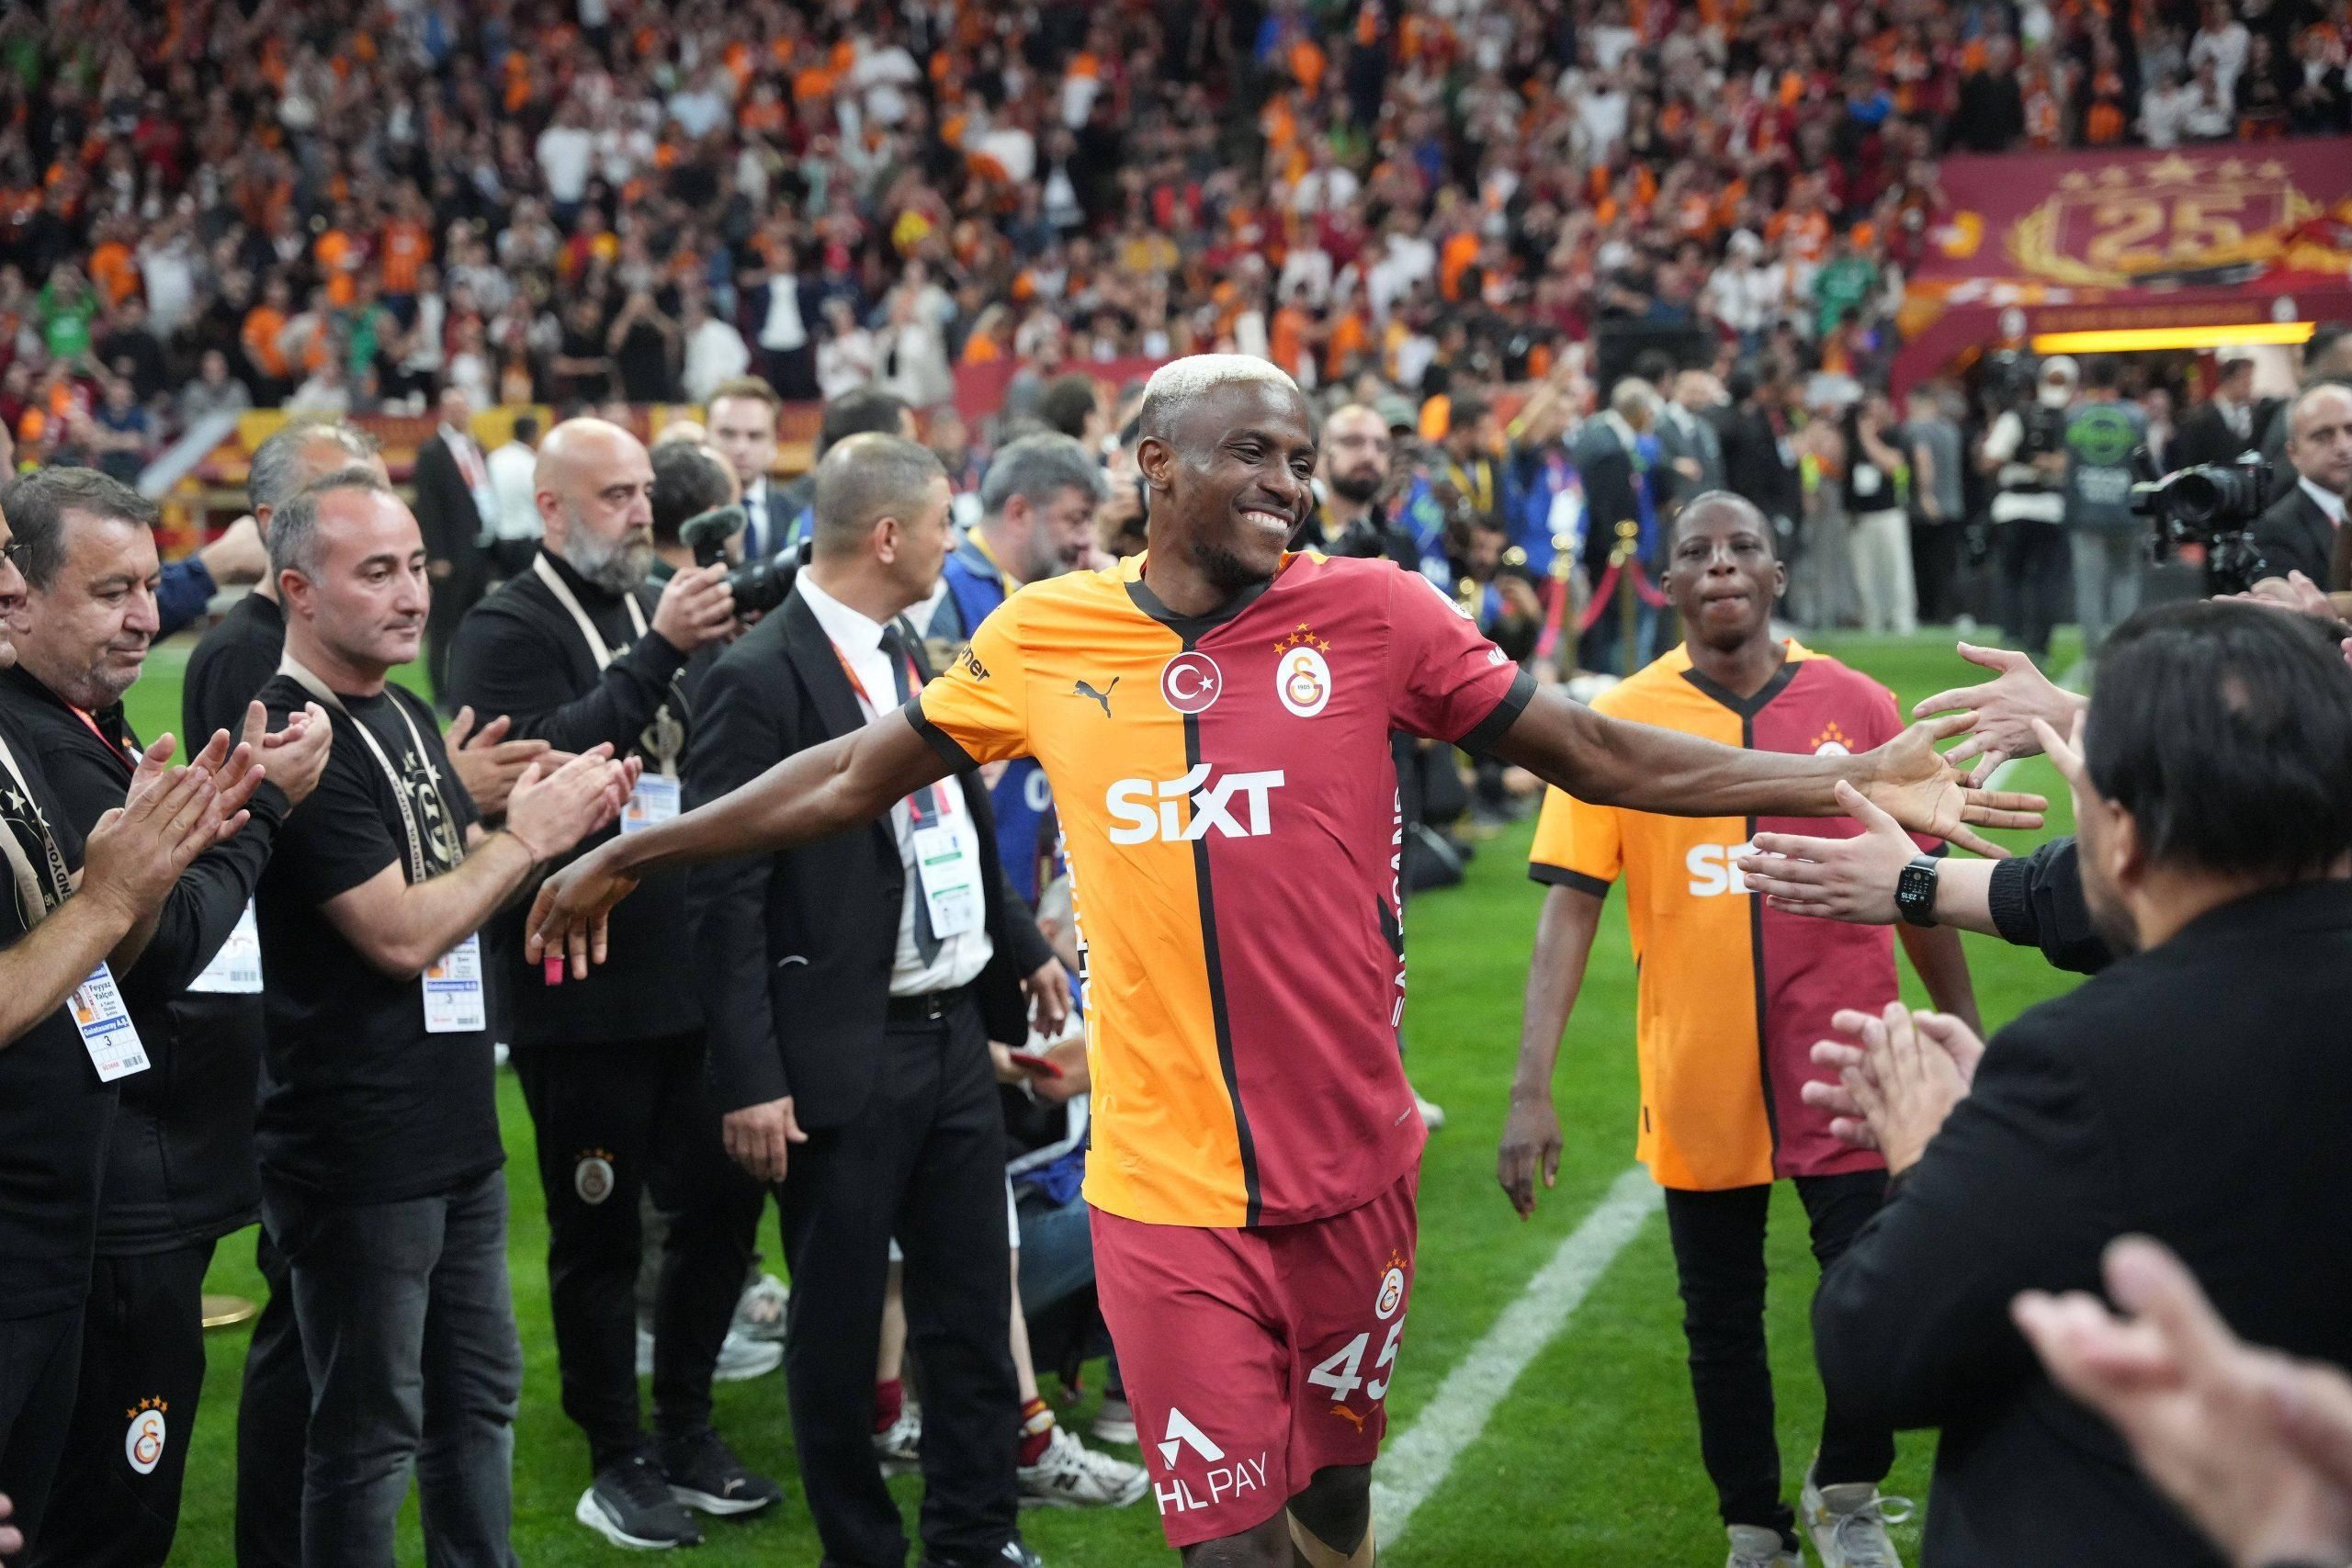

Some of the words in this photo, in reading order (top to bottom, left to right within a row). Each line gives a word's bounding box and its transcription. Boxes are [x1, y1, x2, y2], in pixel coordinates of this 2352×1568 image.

[2087, 196, 2247, 269] 25
[89, 981, 111, 992] Feyyaz
[104, 1035, 112, 1046] 3
[1307, 1314, 1406, 1402] 45
